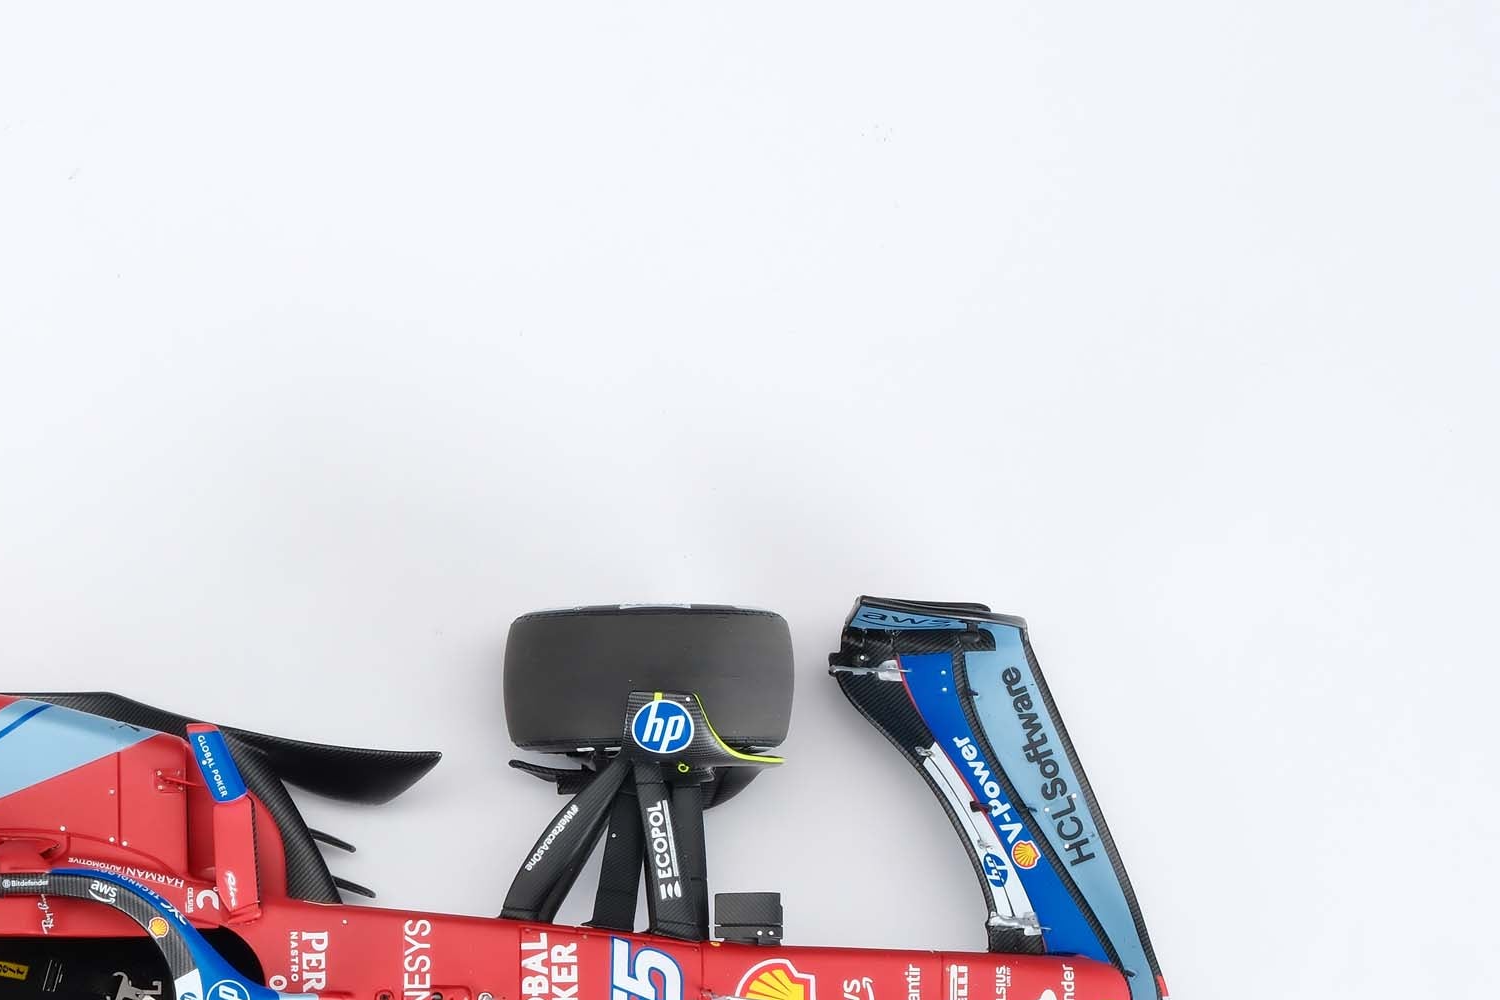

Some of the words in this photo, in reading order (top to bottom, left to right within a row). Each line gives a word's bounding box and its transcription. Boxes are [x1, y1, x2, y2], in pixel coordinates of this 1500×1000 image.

[641, 700, 687, 753] hp
[197, 735, 216, 768] GLOBAL
[211, 769, 228, 798] POKER
[953, 736, 1024, 845] V-Power
[524, 803, 579, 871] #WeRaceAsOne
[646, 800, 673, 879] ECOPOL
[10, 879, 50, 888] Bitdefender
[91, 880, 118, 898] aws
[126, 867, 185, 888] HARMAN
[984, 854, 1007, 883] hp
[289, 931, 299, 983] NASTRO
